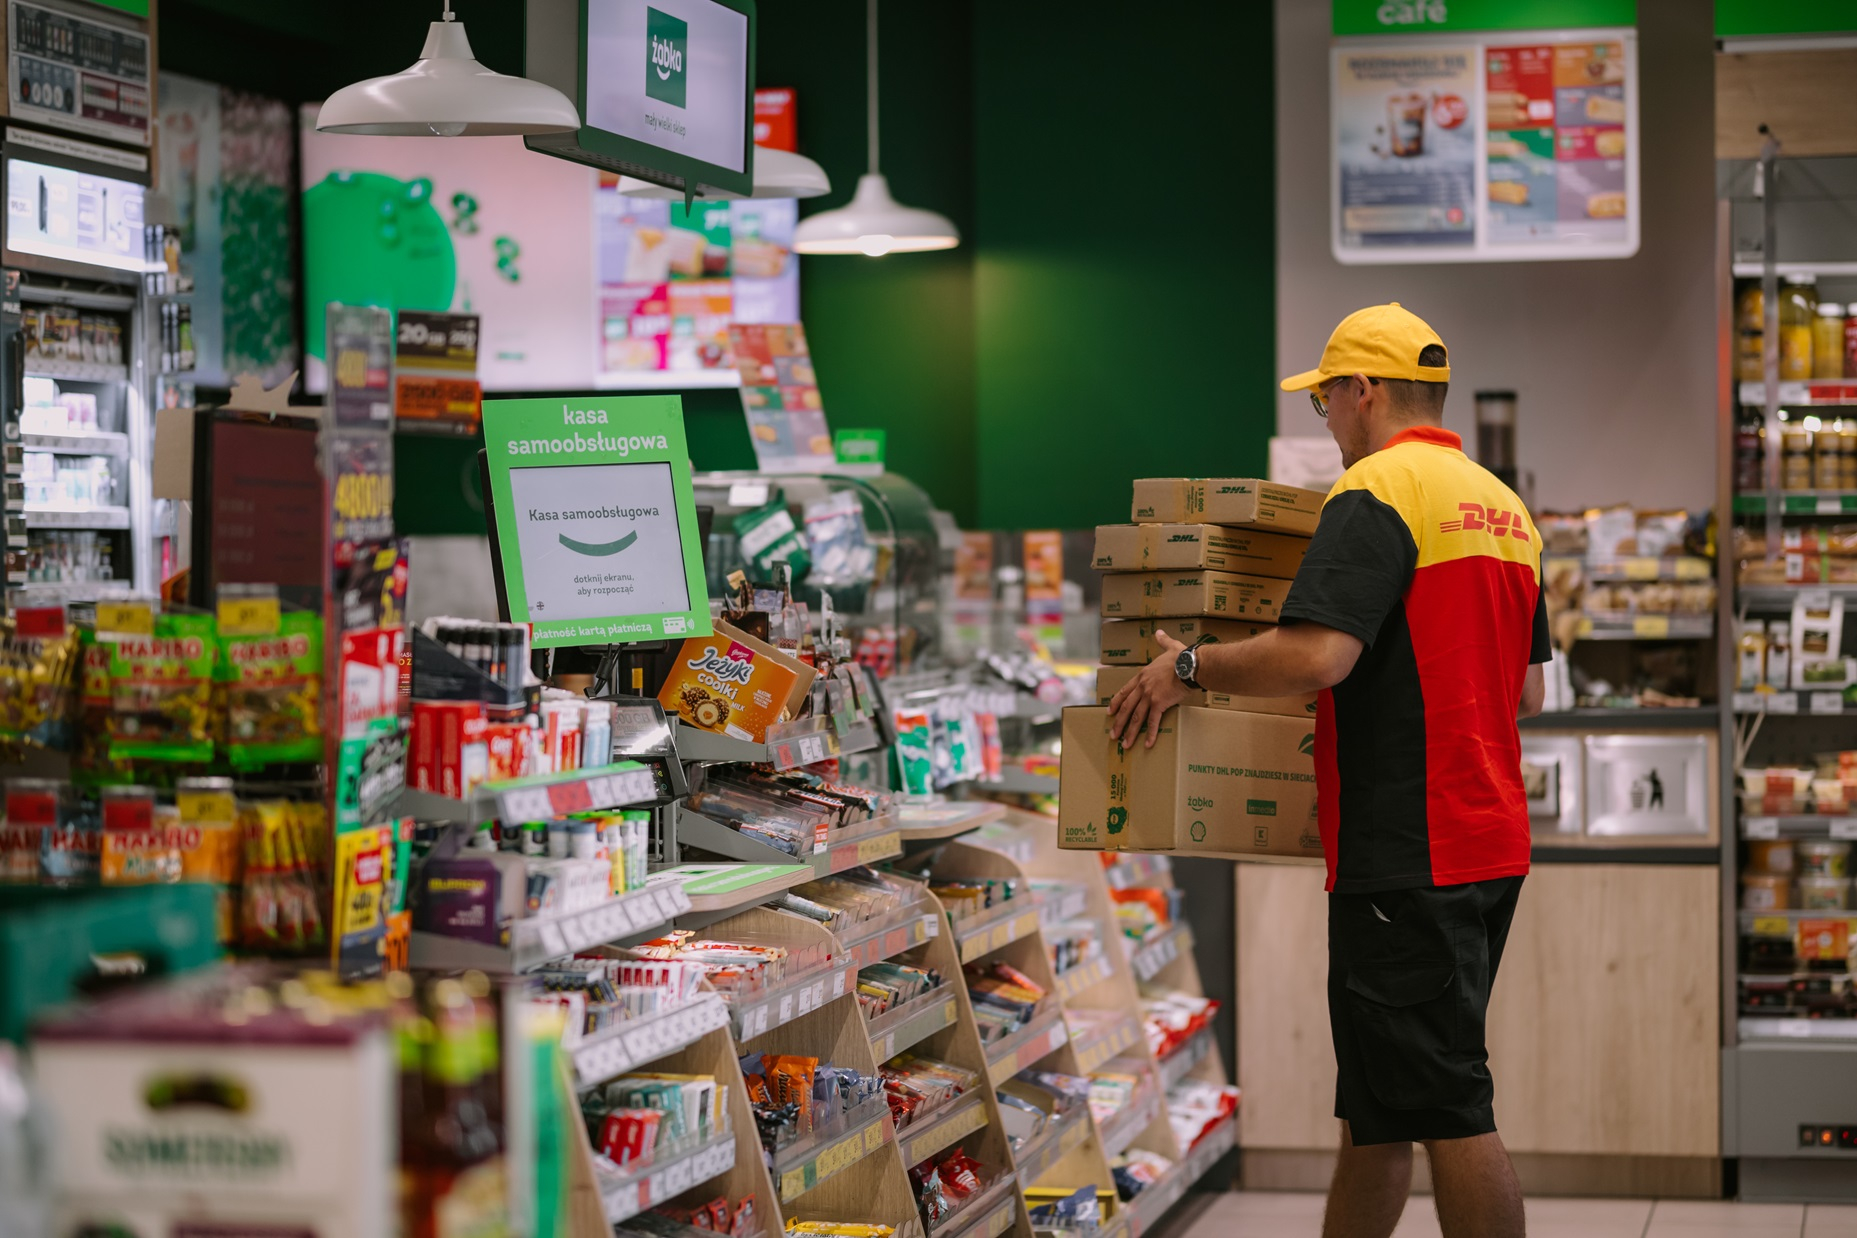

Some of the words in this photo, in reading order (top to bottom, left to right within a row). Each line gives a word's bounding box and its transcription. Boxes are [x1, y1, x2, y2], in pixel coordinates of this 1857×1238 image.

[1377, 0, 1447, 25] café
[652, 34, 682, 73] żabka
[645, 113, 658, 131] mały
[563, 404, 608, 425] kasa
[507, 431, 668, 457] samoobsługowa
[1217, 486, 1251, 494] DHL
[528, 509, 559, 521] Kasa
[562, 505, 660, 521] samoobsługowa
[1457, 502, 1530, 543] DHL
[1168, 534, 1199, 543] DHL
[573, 574, 602, 584] dotknij
[604, 573, 635, 583] ekranu,
[1174, 578, 1203, 587] DHL
[577, 586, 592, 597] aby
[593, 584, 634, 596] rozpocząć
[533, 624, 577, 642] płatność
[578, 624, 607, 638] kartą
[608, 623, 653, 636] płatniczą
[688, 647, 754, 684] Jeżyki
[697, 673, 739, 700] coolki
[731, 701, 746, 712] MILK
[1188, 763, 1215, 775] PUNKTY
[1216, 766, 1230, 776] DHL
[1230, 767, 1244, 777] POP
[1245, 769, 1282, 779] ZNAJDZIESZ
[1283, 772, 1289, 781] W
[1188, 796, 1214, 808] żabka
[1065, 827, 1086, 836] 100%
